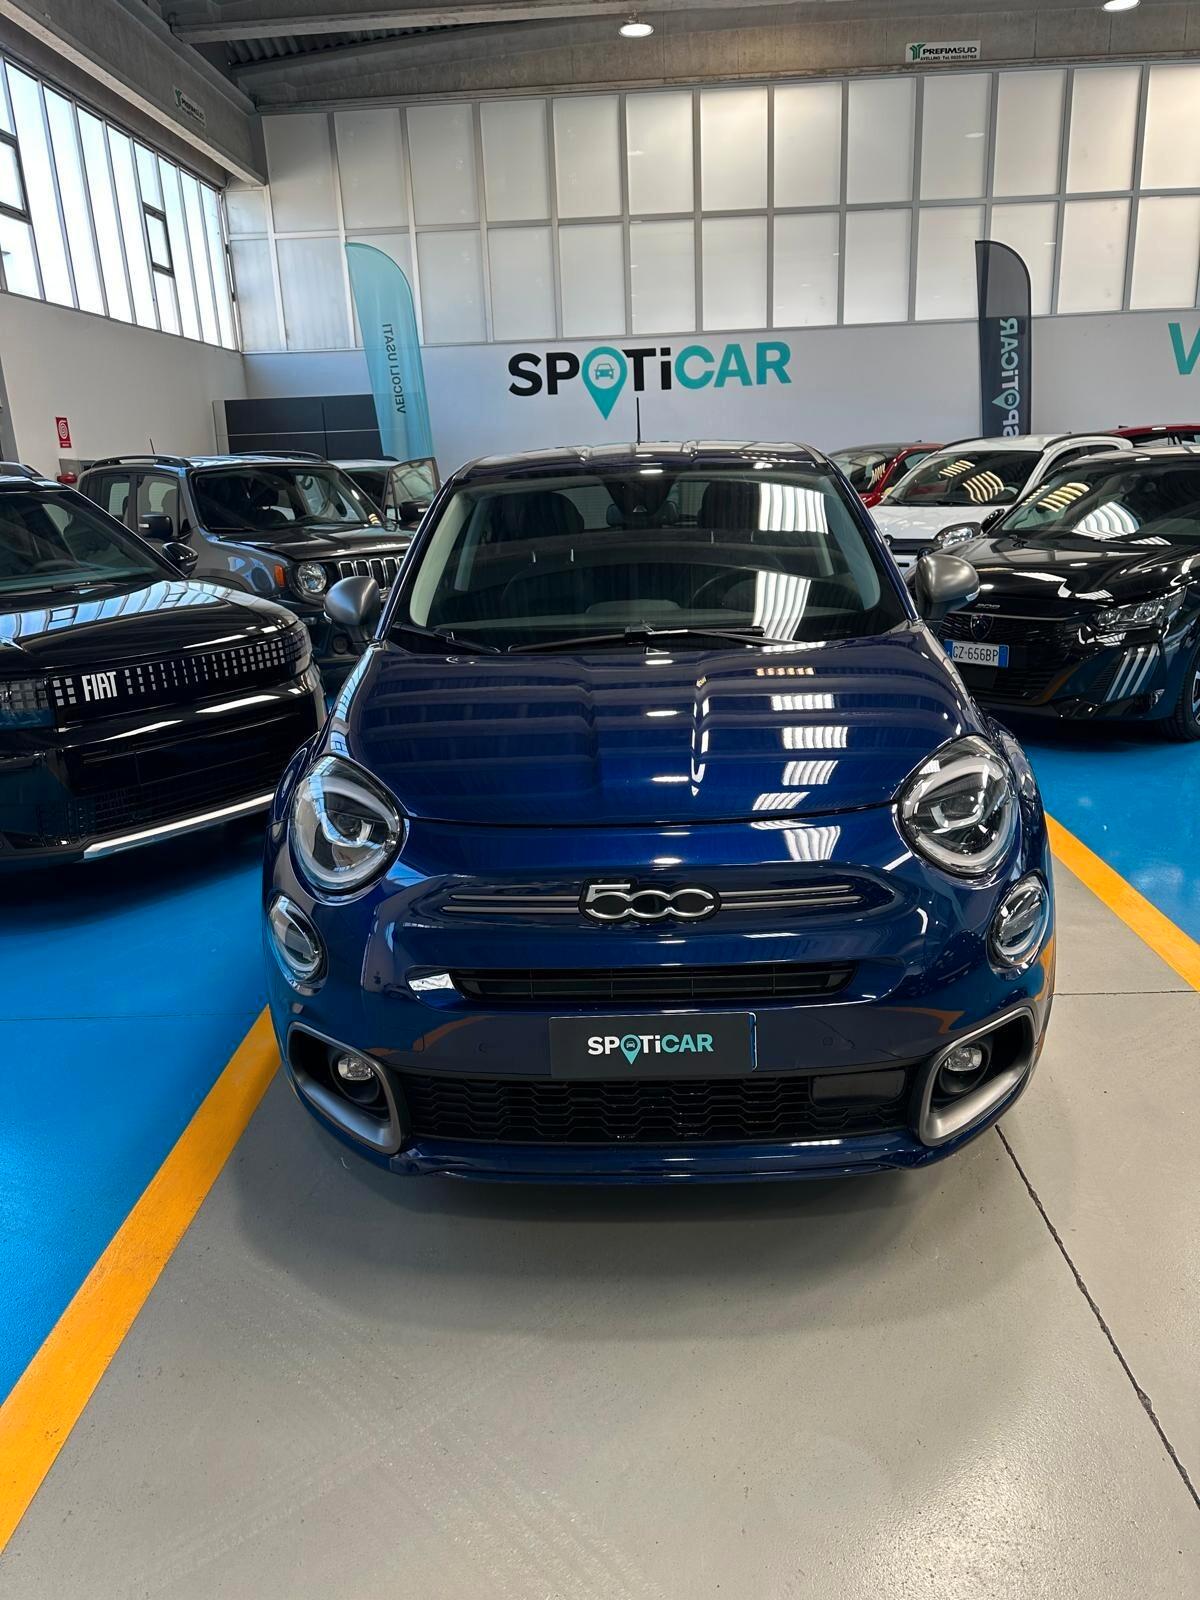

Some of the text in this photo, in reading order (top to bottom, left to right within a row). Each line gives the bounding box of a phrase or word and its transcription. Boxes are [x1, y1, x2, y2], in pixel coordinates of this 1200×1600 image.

[923, 47, 977, 55] PREFIMSUD
[81, 671, 118, 701] FIAT
[585, 883, 715, 920] 500
